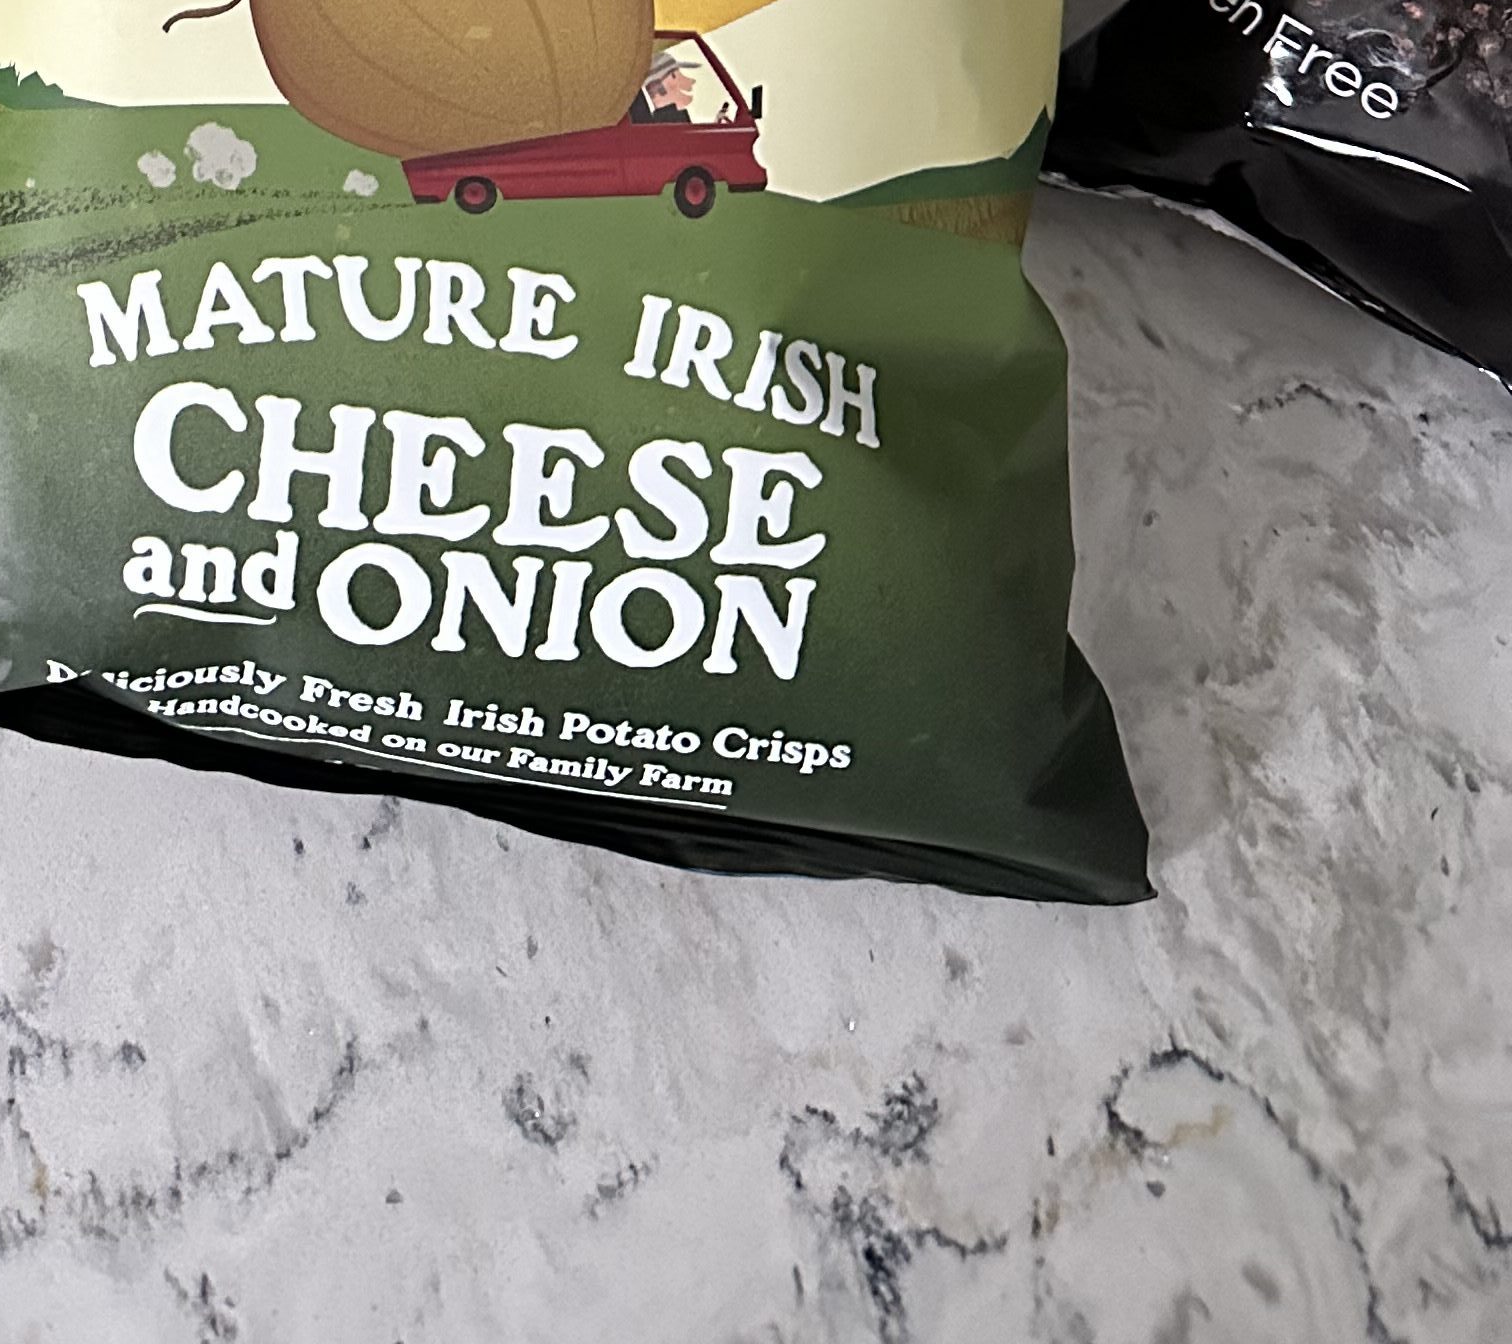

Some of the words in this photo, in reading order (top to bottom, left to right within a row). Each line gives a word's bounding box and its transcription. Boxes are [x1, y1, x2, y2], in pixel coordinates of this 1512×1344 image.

[1262, 13, 1399, 120] Free
[75, 253, 580, 371] MATURE
[622, 291, 882, 450] IRISH
[131, 379, 828, 572] CHEESE
[121, 529, 300, 612] and
[315, 538, 818, 682] ONION
[45, 659, 286, 695] Diciously
[299, 673, 425, 722] Fresh
[442, 699, 546, 739] Irish
[559, 712, 702, 757] Potato
[711, 726, 855, 775] Crisps
[146, 697, 373, 745] Handcooked
[380, 732, 428, 754] on
[436, 739, 502, 767] our
[505, 745, 637, 788] Family
[638, 762, 736, 796] Farm
